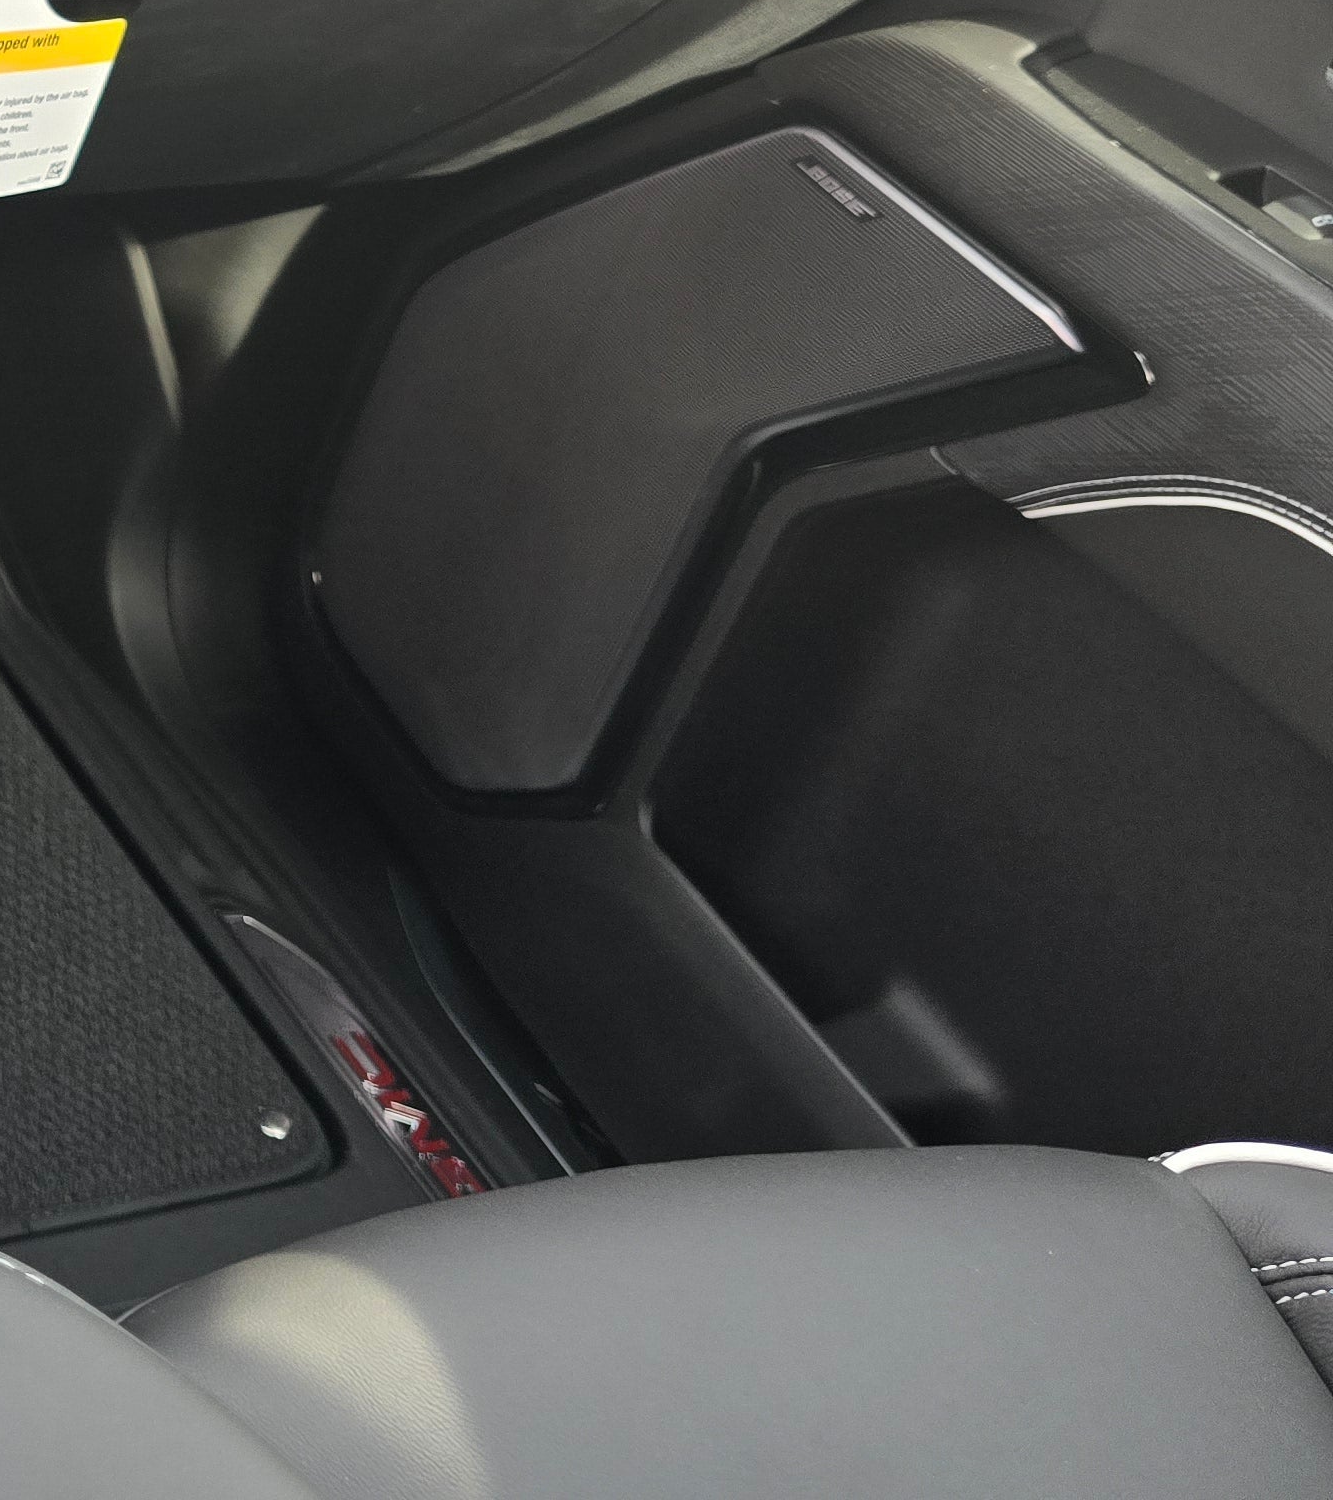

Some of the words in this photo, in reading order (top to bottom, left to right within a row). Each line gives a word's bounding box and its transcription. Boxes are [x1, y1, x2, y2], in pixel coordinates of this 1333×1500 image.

[32, 33, 60, 48] with
[3, 96, 34, 107] injured
[33, 94, 44, 104] by
[45, 93, 59, 102] the
